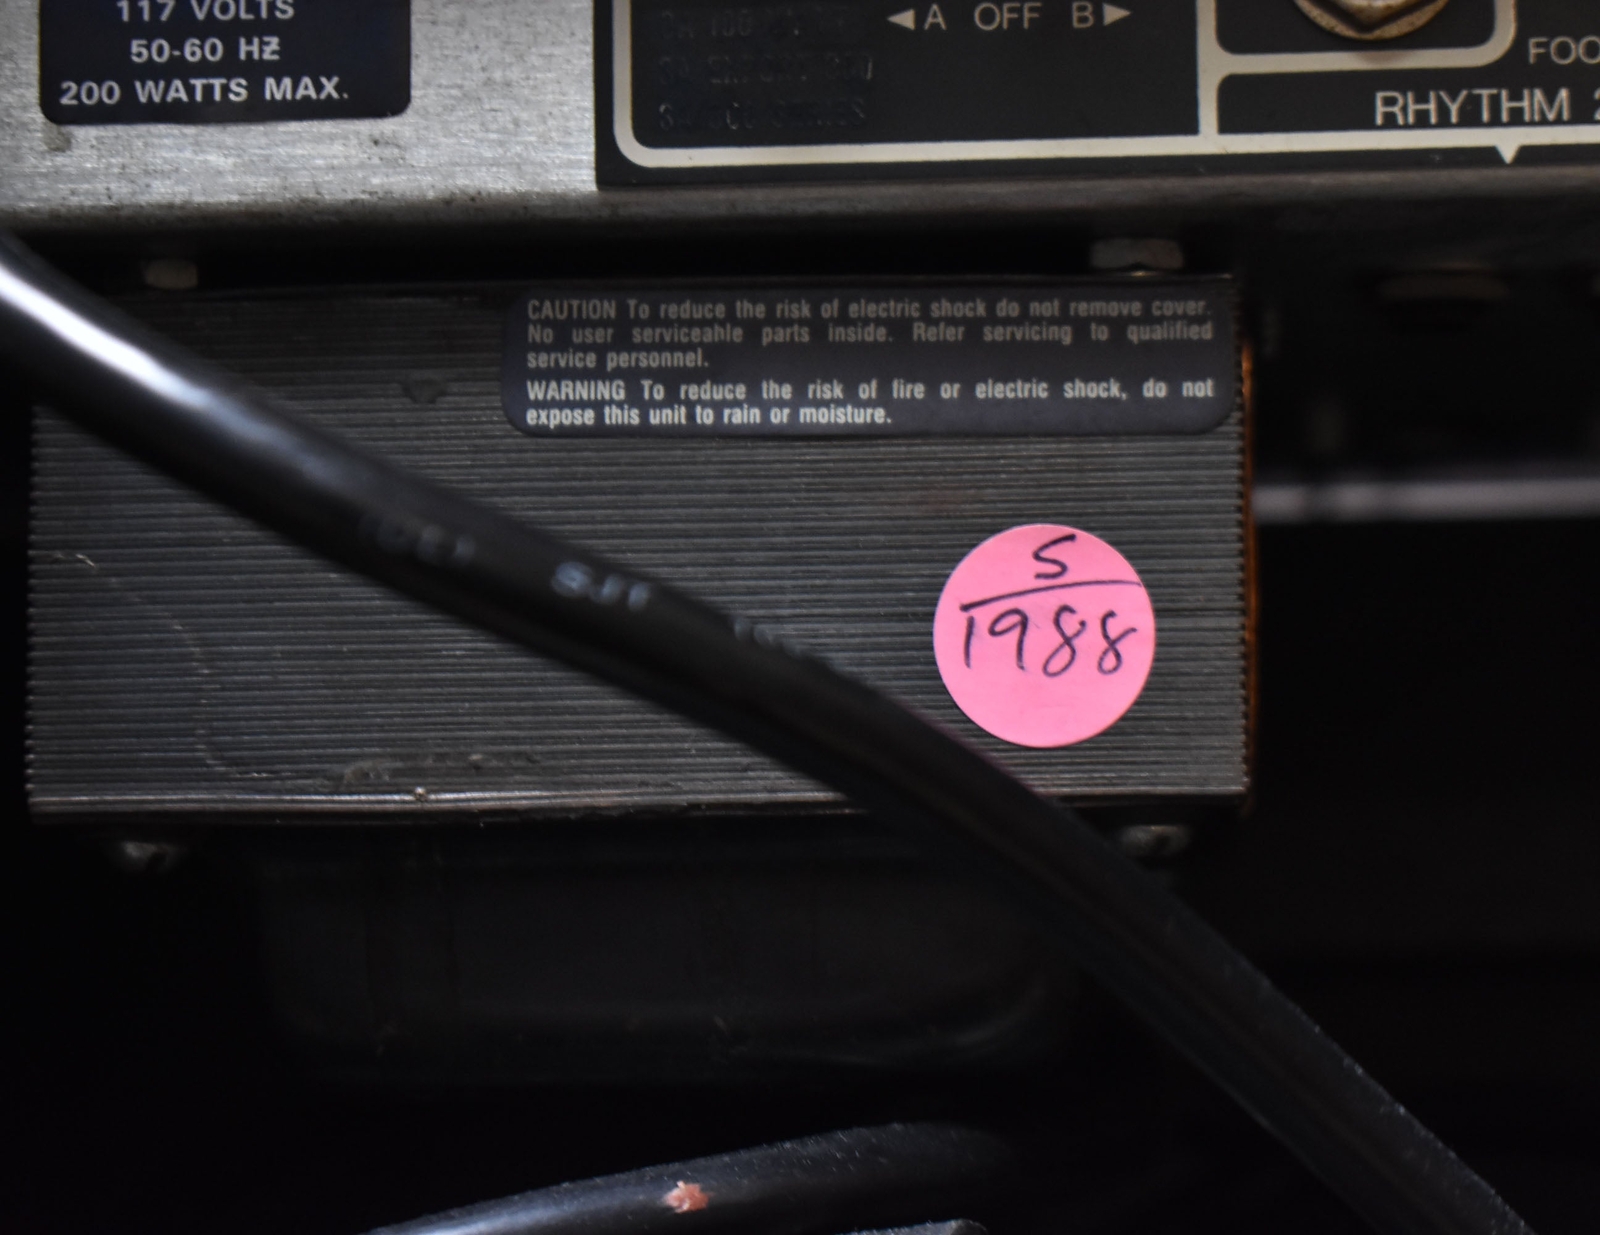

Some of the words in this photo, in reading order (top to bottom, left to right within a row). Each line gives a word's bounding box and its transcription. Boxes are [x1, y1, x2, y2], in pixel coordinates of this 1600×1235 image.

[116, 0, 176, 22] 117
[190, 0, 295, 21] VOLTS
[923, 4, 947, 31] A
[974, 3, 1042, 31] OFF
[1071, 1, 1095, 29] B
[130, 37, 224, 63] 50-60
[1528, 36, 1600, 65] FOO
[60, 80, 121, 105] 200
[135, 77, 248, 103] WATTS
[264, 75, 349, 101] MAX.
[1375, 88, 1571, 126] RHYTHM
[527, 299, 616, 320] CAUTION
[627, 299, 650, 319] To
[660, 299, 726, 319] reduce
[736, 299, 766, 319] the
[776, 299, 812, 319] risk
[821, 299, 839, 319] of
[848, 298, 920, 319] electric
[930, 298, 986, 319] shock
[996, 298, 1020, 318] do
[1029, 299, 1060, 318] not
[1069, 301, 1142, 318] remove
[1151, 299, 1212, 317] cover.
[527, 324, 554, 343] No
[572, 327, 614, 343] user
[762, 324, 810, 346] parts
[828, 323, 893, 343] inside.
[912, 322, 965, 342] Refer
[983, 322, 1073, 345] servicing
[1091, 322, 1109, 341] to
[1126, 321, 1213, 344] qualified
[527, 350, 597, 369] service
[606, 349, 709, 371] personnel.
[526, 380, 626, 401] WARNING
[640, 380, 664, 400] To
[680, 379, 747, 400] reduce
[761, 379, 793, 400] the
[807, 379, 844, 400] risk
[858, 379, 878, 399] of
[892, 379, 926, 400] fire
[940, 382, 961, 399] or
[975, 378, 1049, 400] electric
[1063, 378, 1128, 400] shock,
[1142, 378, 1168, 399] do
[1182, 379, 1215, 398] not
[526, 408, 595, 429] expose
[603, 405, 640, 426] this
[649, 405, 688, 426] unit
[696, 405, 714, 426] to
[722, 405, 761, 425] rain
[770, 407, 791, 425] or
[799, 404, 892, 425] moisture.
[963, 604, 1137, 678] 1988
